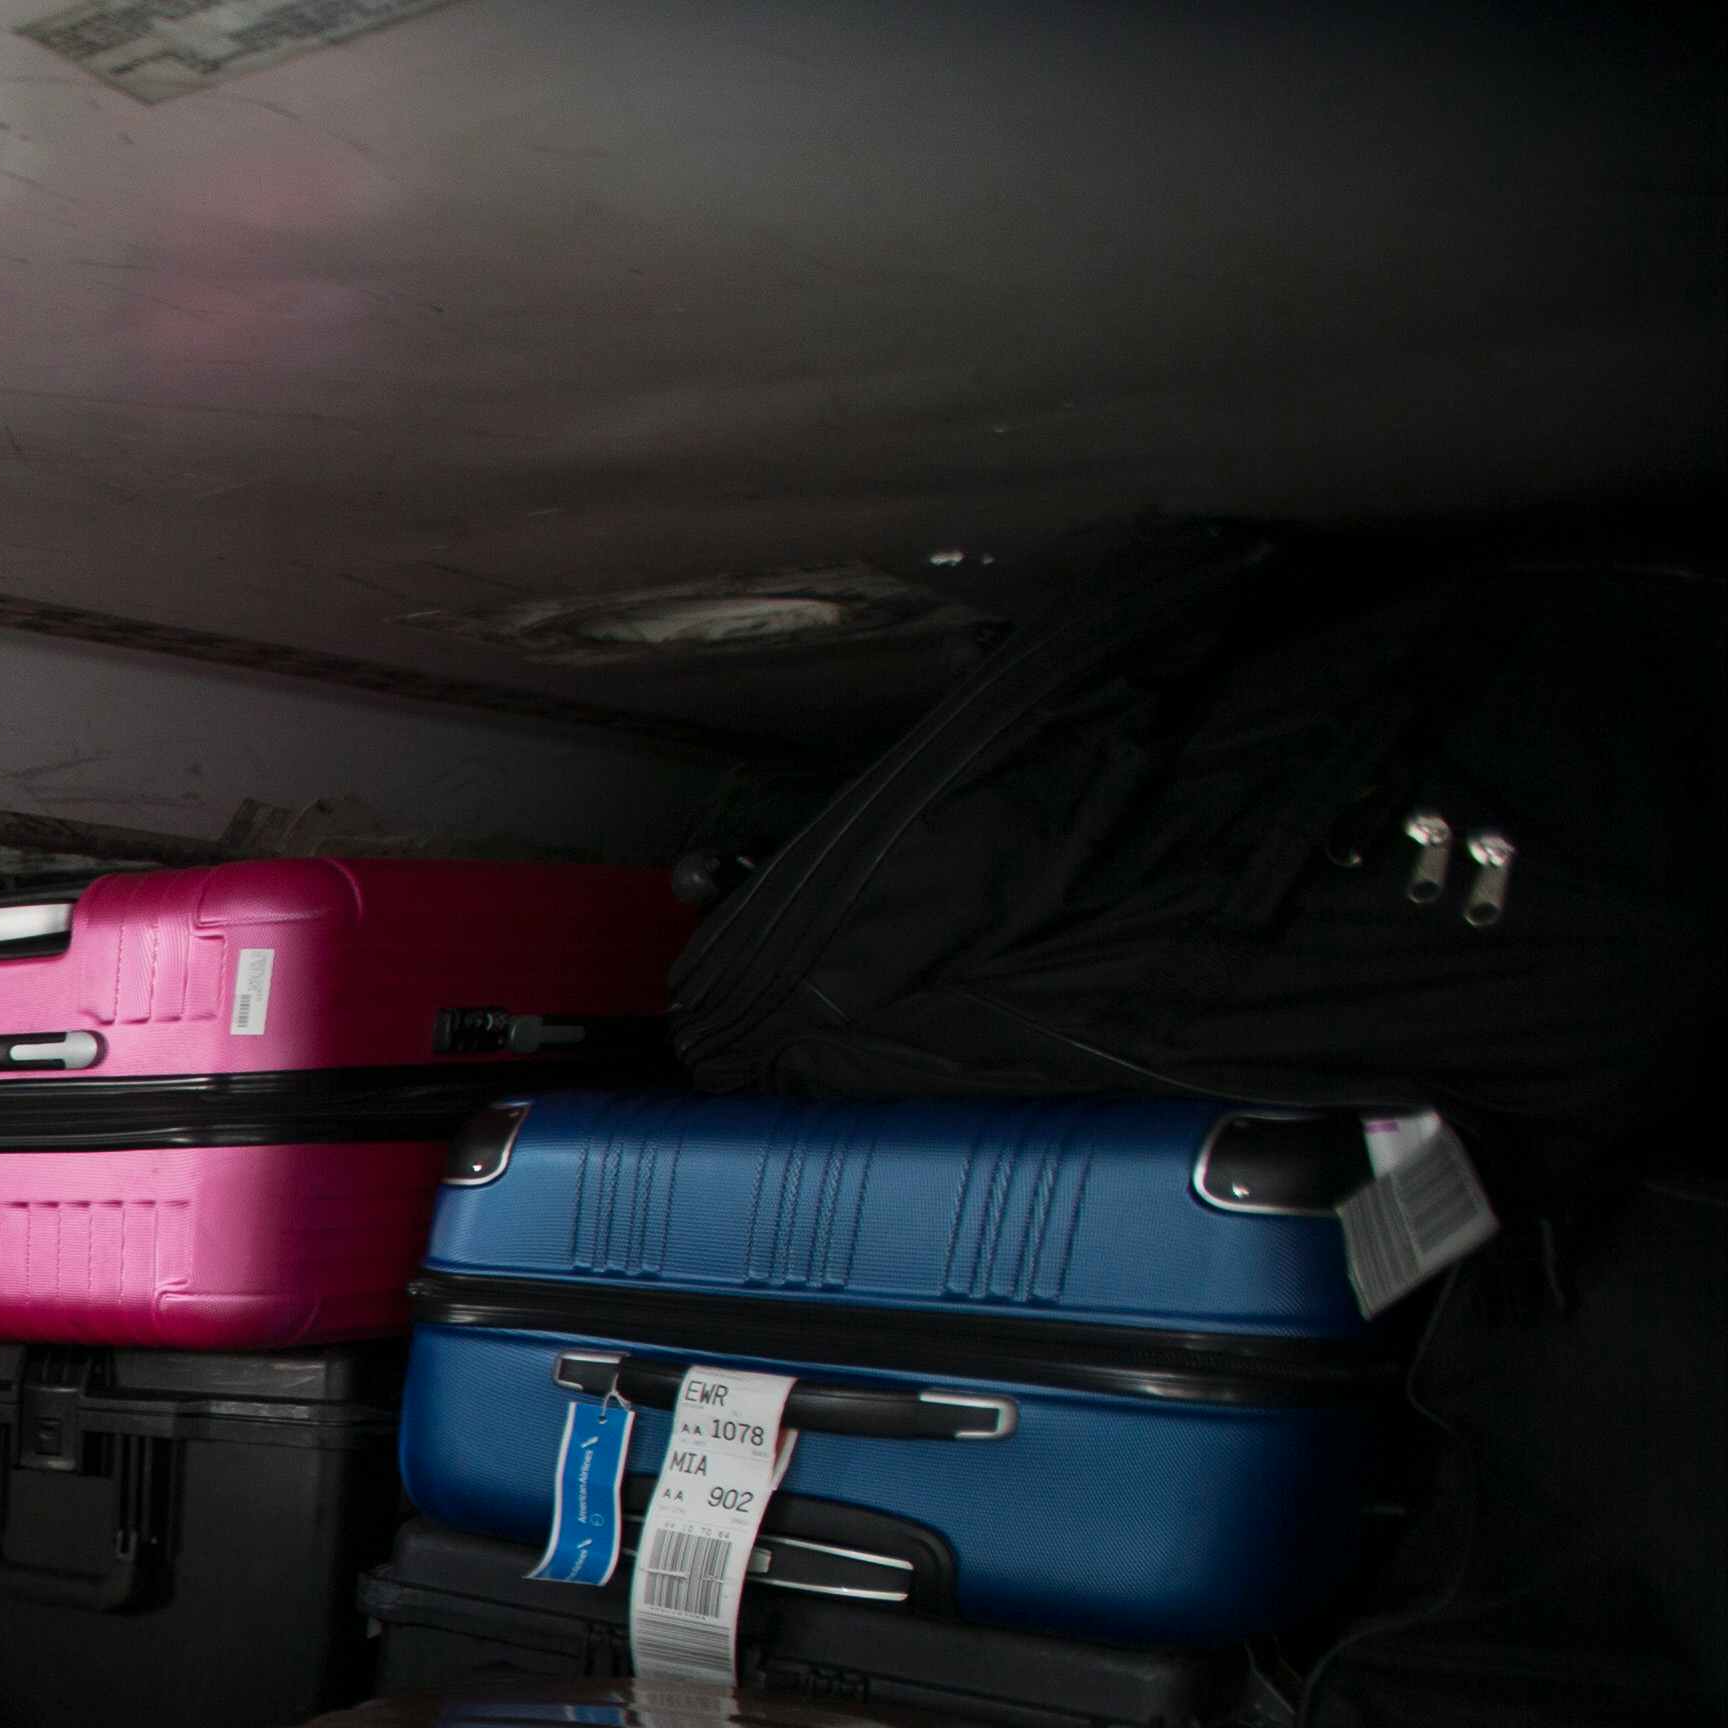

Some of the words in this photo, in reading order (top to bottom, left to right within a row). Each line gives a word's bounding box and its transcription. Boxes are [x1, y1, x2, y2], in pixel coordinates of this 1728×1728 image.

[684, 1380, 729, 1407] EWR
[711, 1418, 765, 1447] 1078
[669, 1450, 709, 1477] MIA
[707, 1485, 755, 1513] 902
